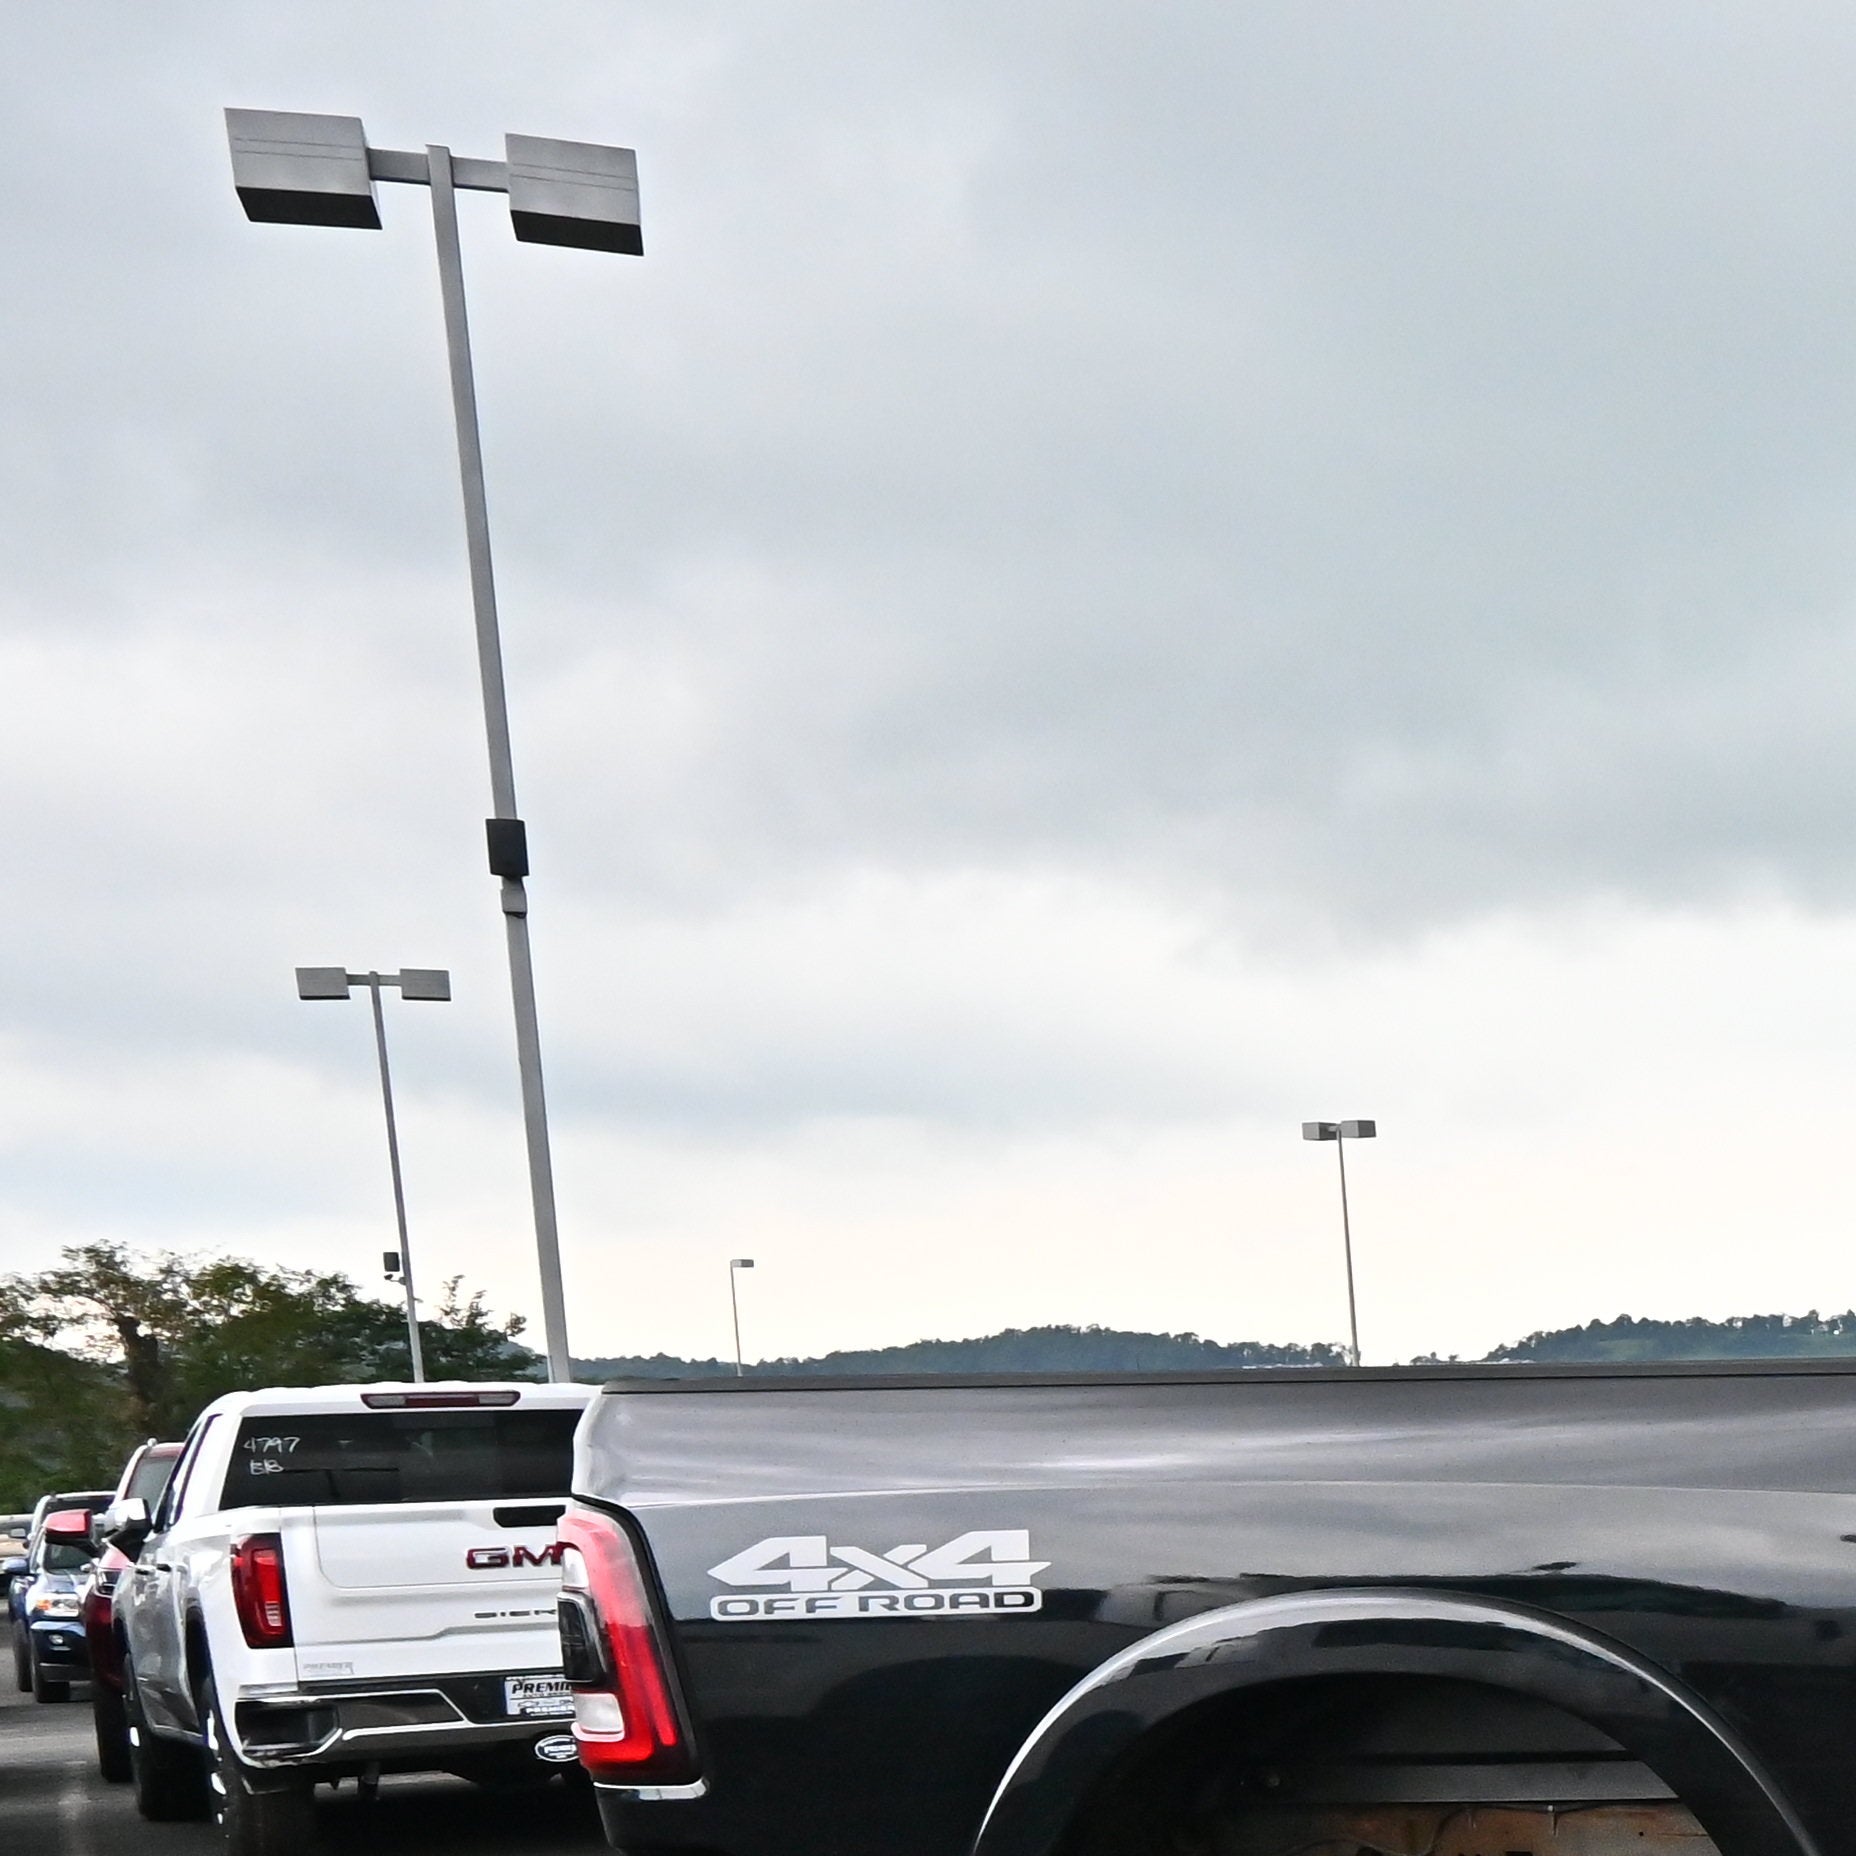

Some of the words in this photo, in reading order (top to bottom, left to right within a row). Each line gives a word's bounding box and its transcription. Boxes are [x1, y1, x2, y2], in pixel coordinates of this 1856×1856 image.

[243, 1436, 301, 1453] 4797
[466, 1545, 562, 1570] GM
[717, 1596, 842, 1617] OFF
[858, 1591, 1035, 1613] ROAD
[511, 1680, 571, 1694] PREMI
